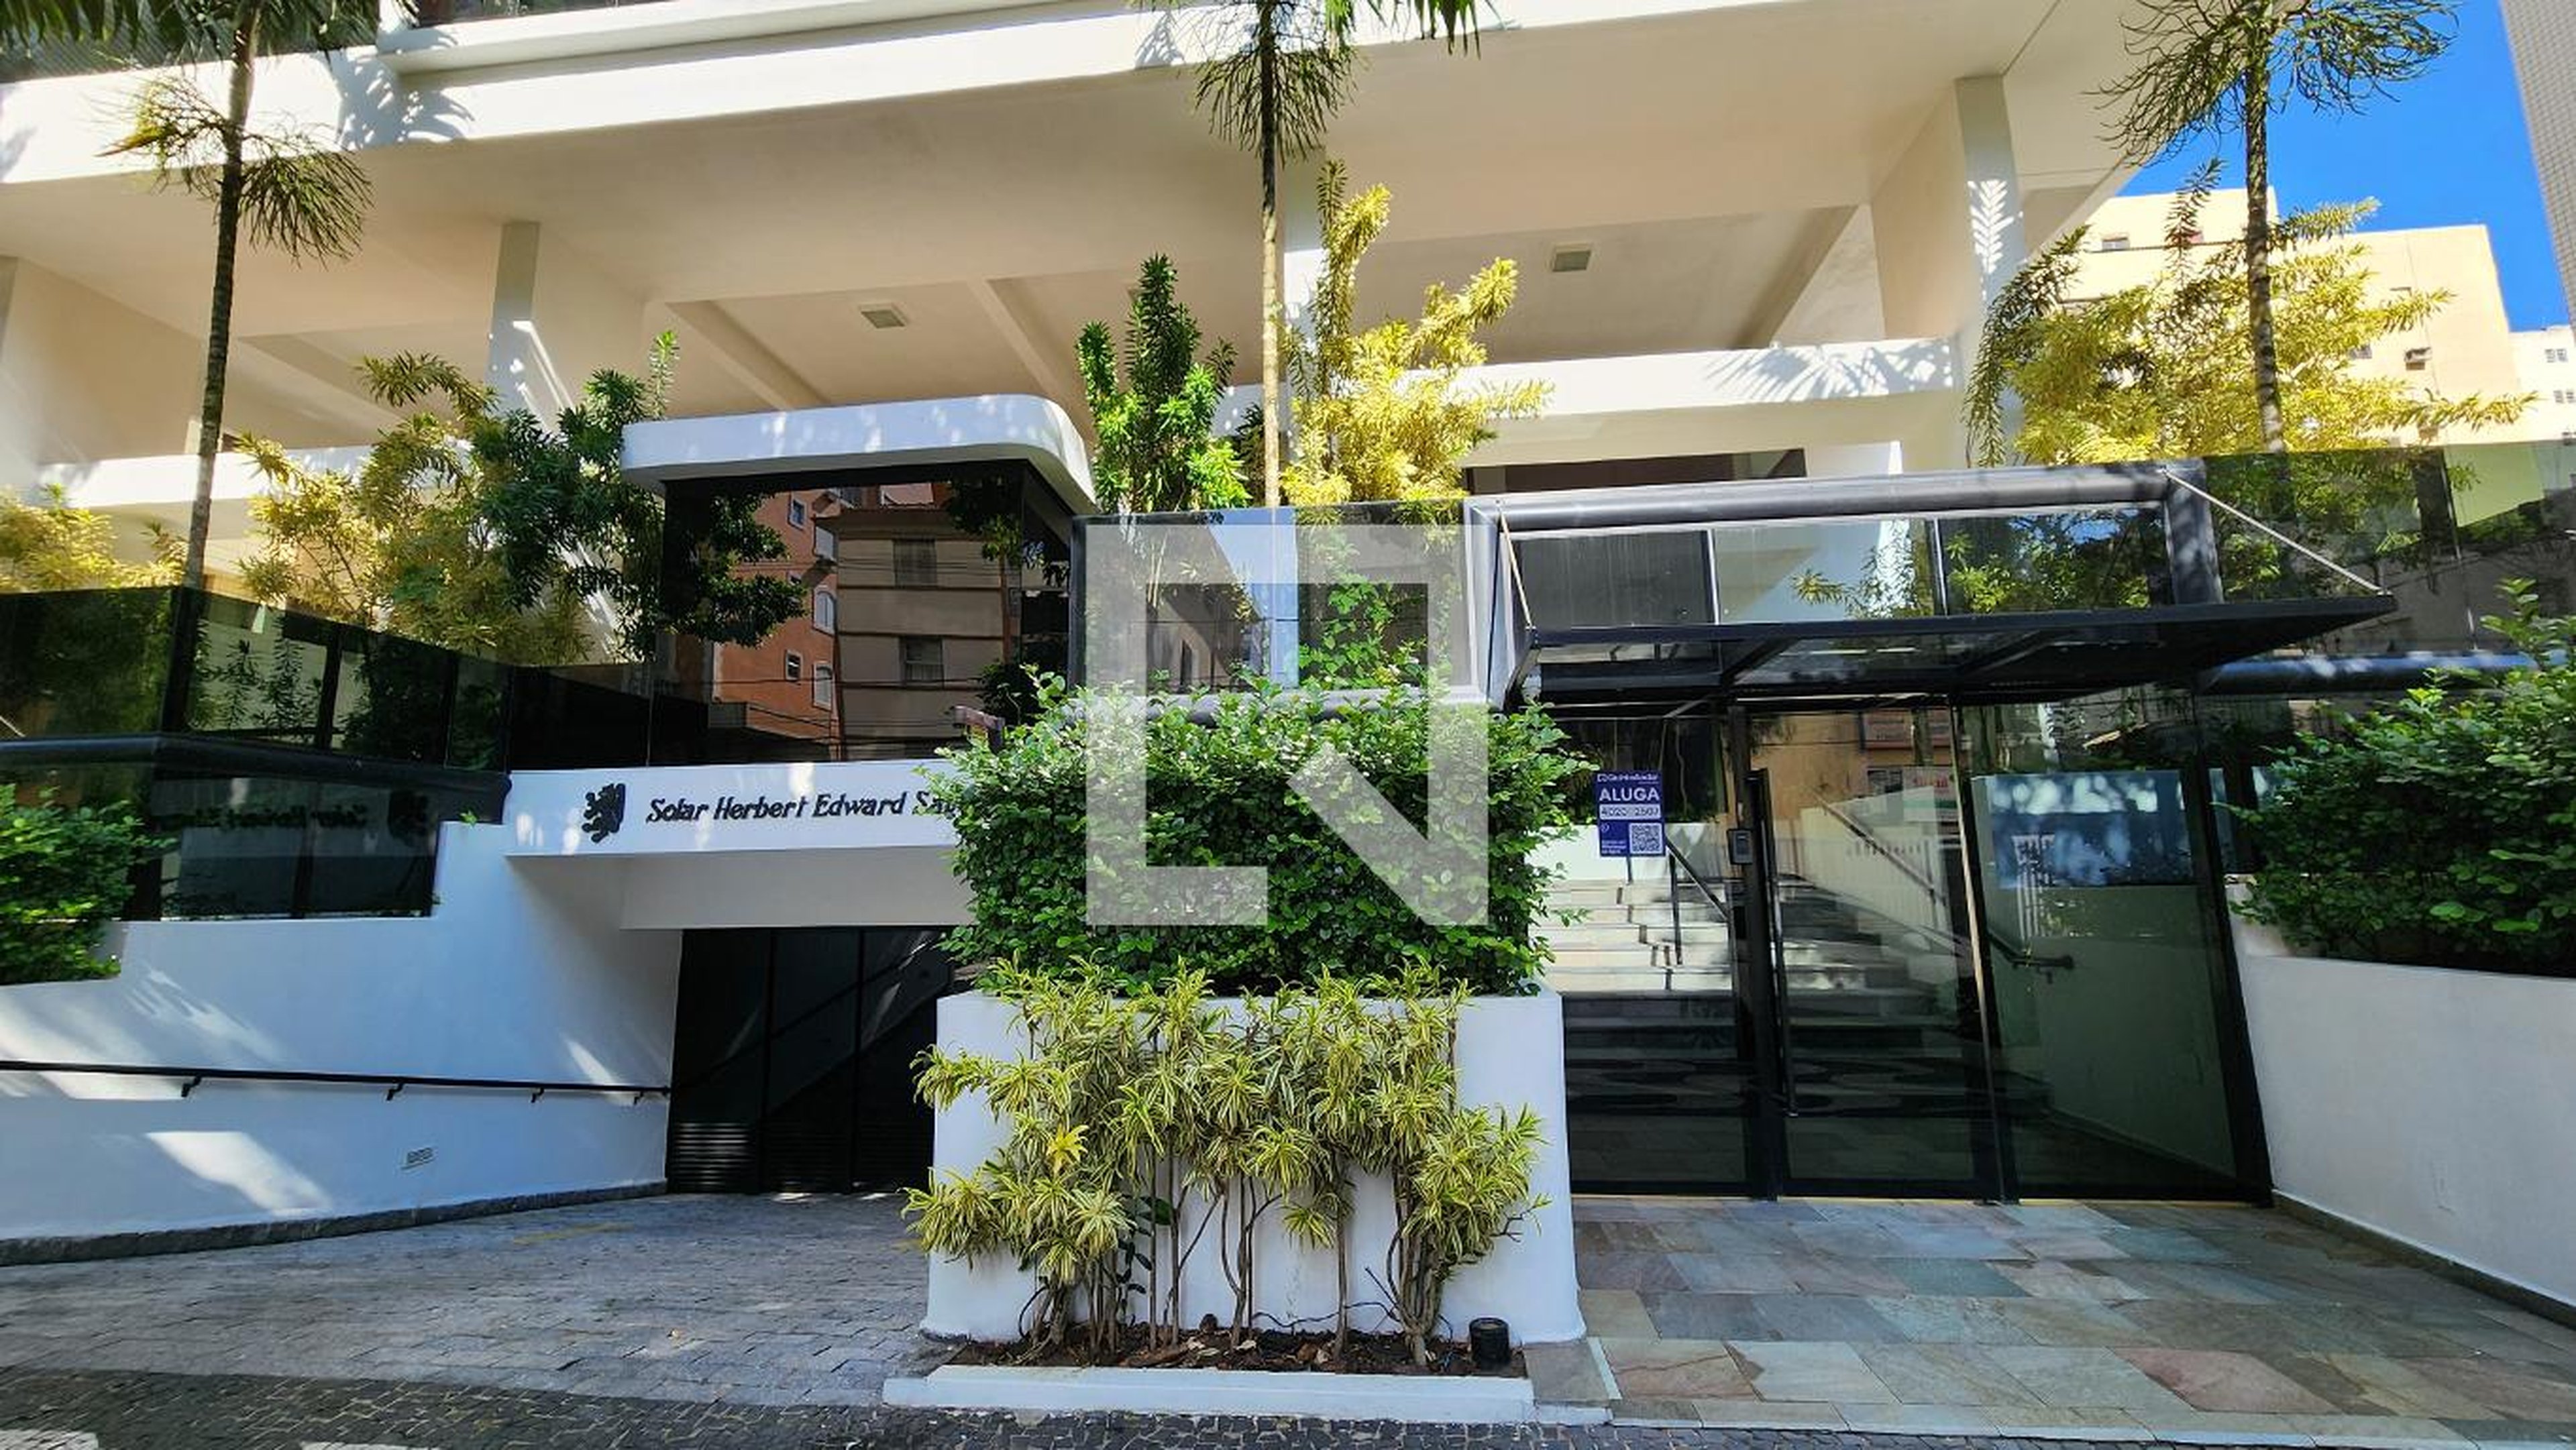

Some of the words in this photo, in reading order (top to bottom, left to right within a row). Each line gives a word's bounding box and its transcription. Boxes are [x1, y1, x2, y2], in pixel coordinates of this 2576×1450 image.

[1599, 787, 1660, 801] ALUGA
[645, 797, 709, 823] Solar
[713, 796, 809, 820] Herbert
[812, 791, 907, 818] Edward
